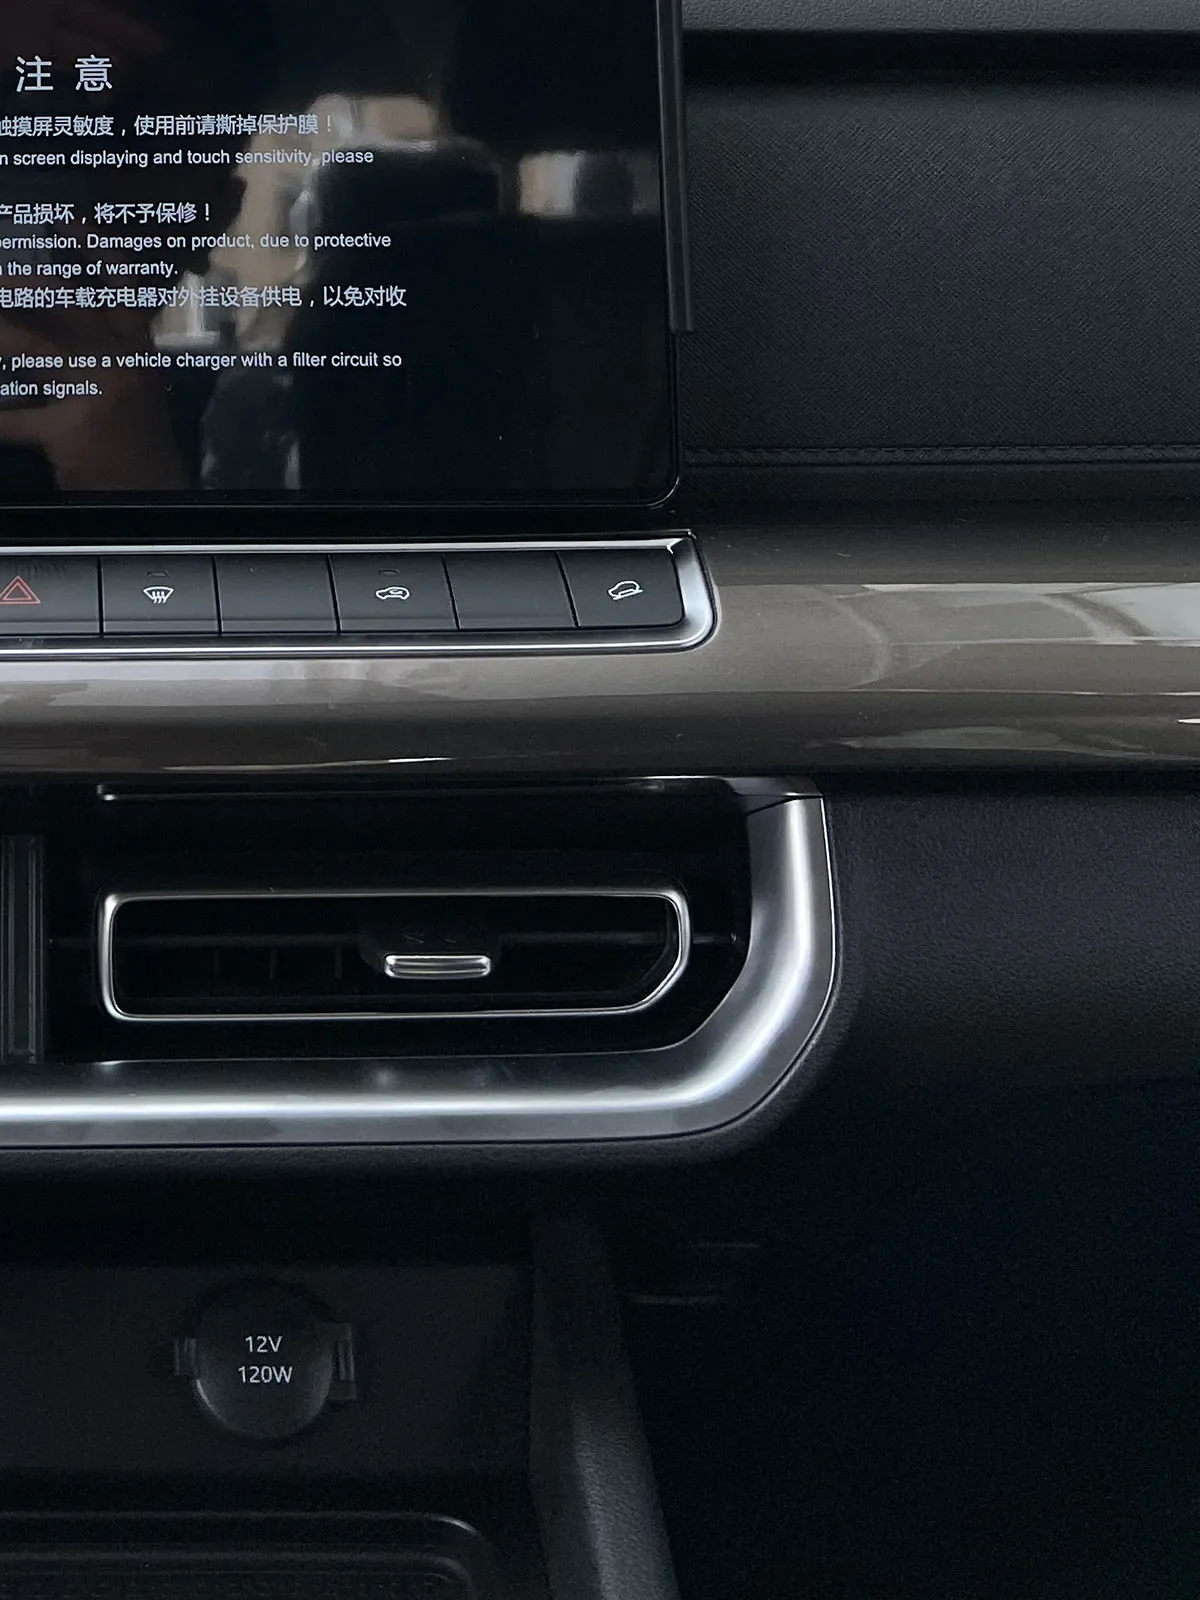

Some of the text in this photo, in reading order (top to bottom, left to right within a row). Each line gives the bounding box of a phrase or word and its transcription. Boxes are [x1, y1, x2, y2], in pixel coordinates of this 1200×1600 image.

[12, 153, 66, 167] screen
[69, 148, 149, 169] displaying
[152, 149, 183, 166] and
[186, 148, 231, 165] touch
[321, 148, 375, 167] please
[86, 232, 163, 253] Damages
[166, 235, 187, 249] on
[191, 232, 255, 252] product,
[259, 232, 290, 248] due
[293, 233, 310, 249] to
[313, 232, 392, 252] protective
[6, 260, 36, 277] the
[36, 263, 83, 280] range
[85, 259, 103, 276] of
[105, 260, 179, 280] warranty.
[11, 352, 64, 373] please
[67, 355, 97, 368] use
[100, 355, 112, 368] a
[115, 351, 172, 369] vehicle
[175, 351, 239, 372] charger
[240, 351, 273, 368] with
[277, 354, 289, 368] a
[292, 350, 328, 368] filter
[330, 351, 379, 368] circuit
[382, 354, 403, 367] so
[42, 378, 103, 399] signals.
[245, 1335, 283, 1353] 12V
[237, 1365, 293, 1384] 120W
